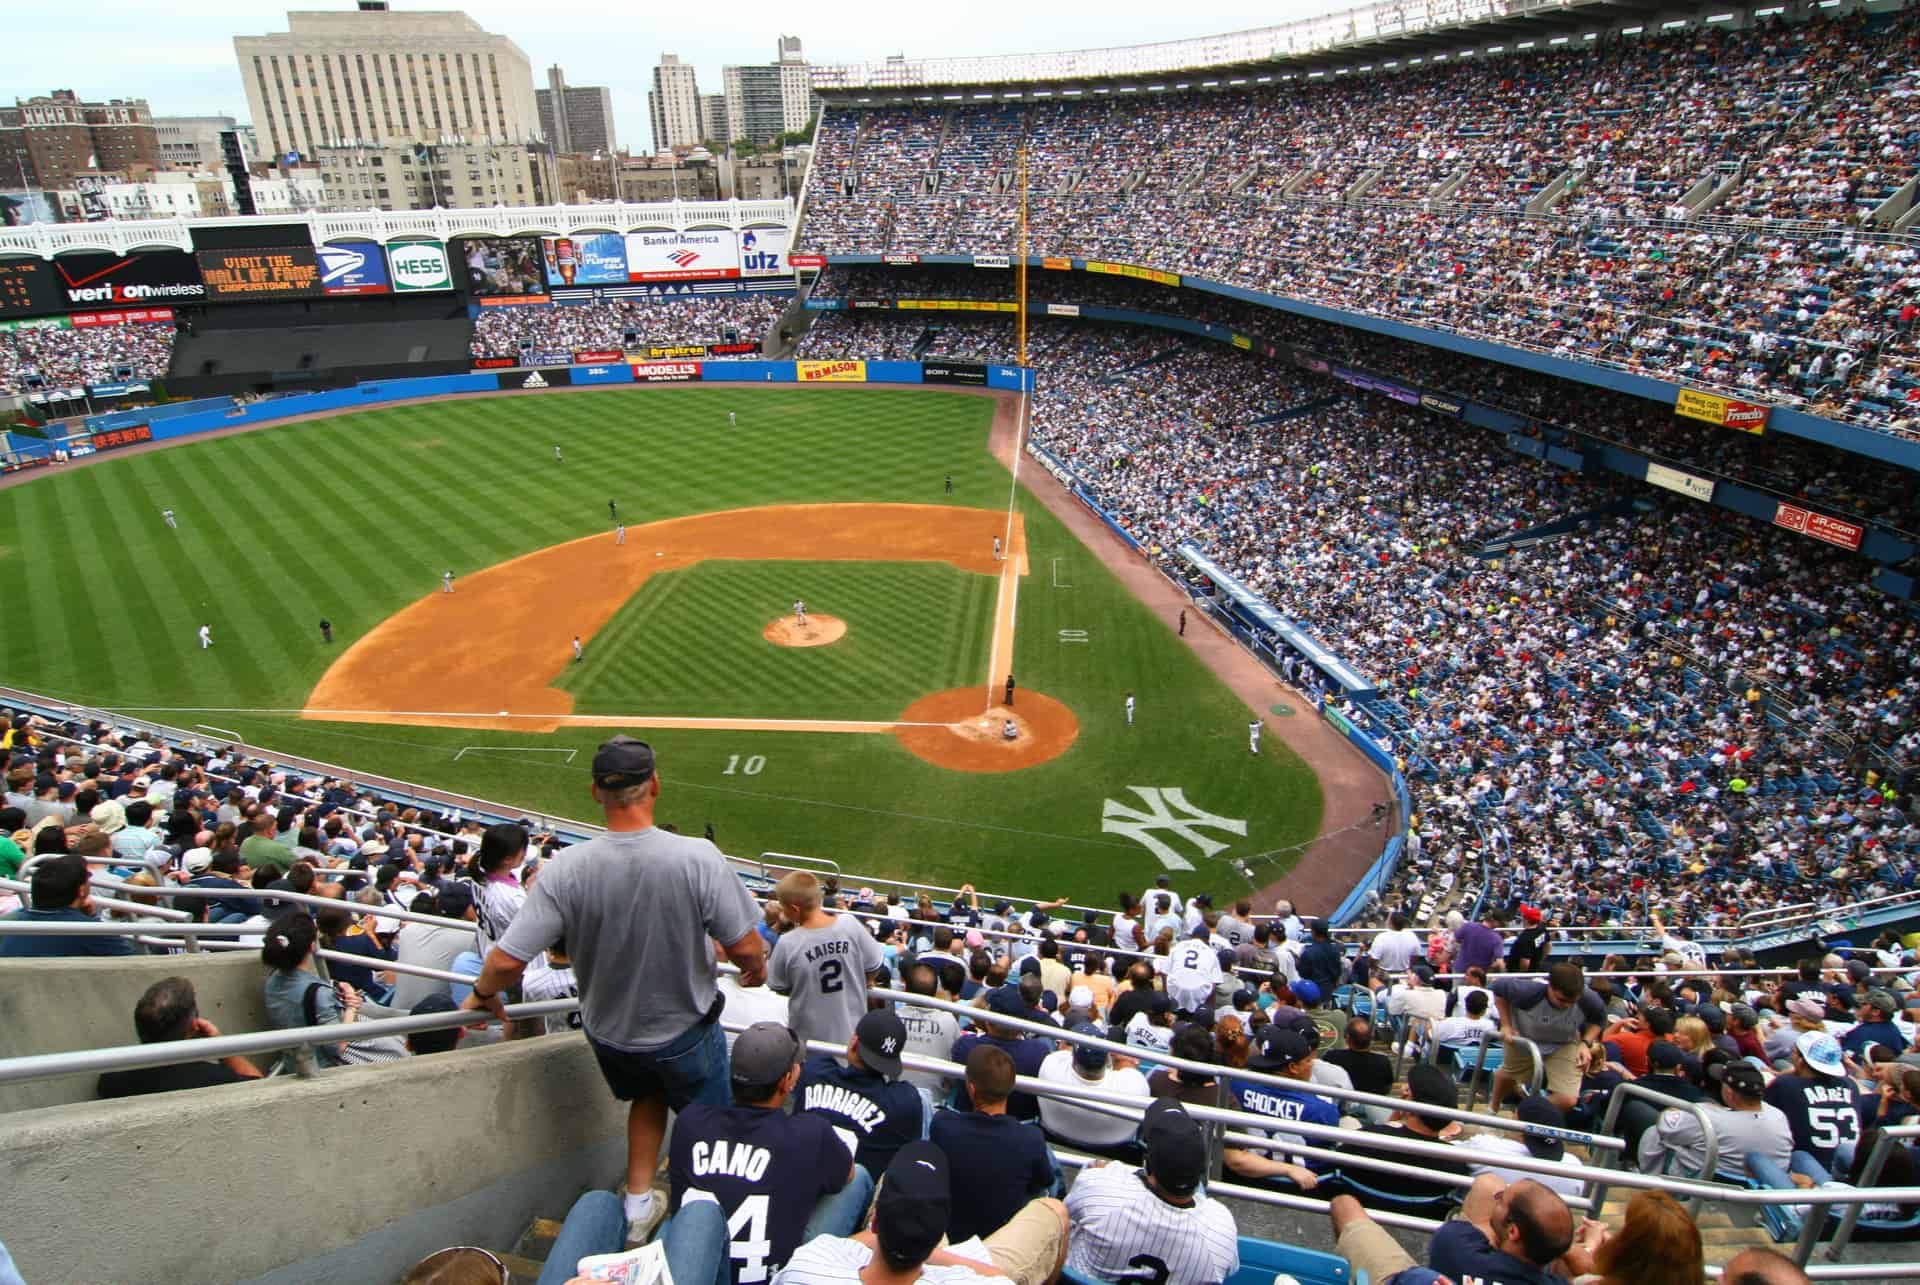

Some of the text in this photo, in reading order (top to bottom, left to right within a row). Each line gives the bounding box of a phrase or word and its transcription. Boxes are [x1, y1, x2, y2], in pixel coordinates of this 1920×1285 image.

[643, 235, 719, 245] Bank of America
[224, 255, 293, 268] VISIT THE
[395, 259, 442, 274] HESS
[745, 251, 779, 269] utz
[68, 283, 204, 302] verizon wireless
[650, 346, 704, 356] Armitron
[638, 364, 696, 376] MODELL'S
[1812, 516, 1856, 535] JR.com
[722, 754, 767, 776] 10
[1229, 931, 1241, 946] 2
[804, 940, 850, 963] KAISER
[1184, 950, 1199, 969] 2
[818, 959, 844, 994] 2
[804, 1084, 886, 1134] RODRIGUEZ
[1243, 1089, 1305, 1120] SHOCKEY
[1807, 1107, 1861, 1149] 53
[692, 1141, 771, 1182] CANO
